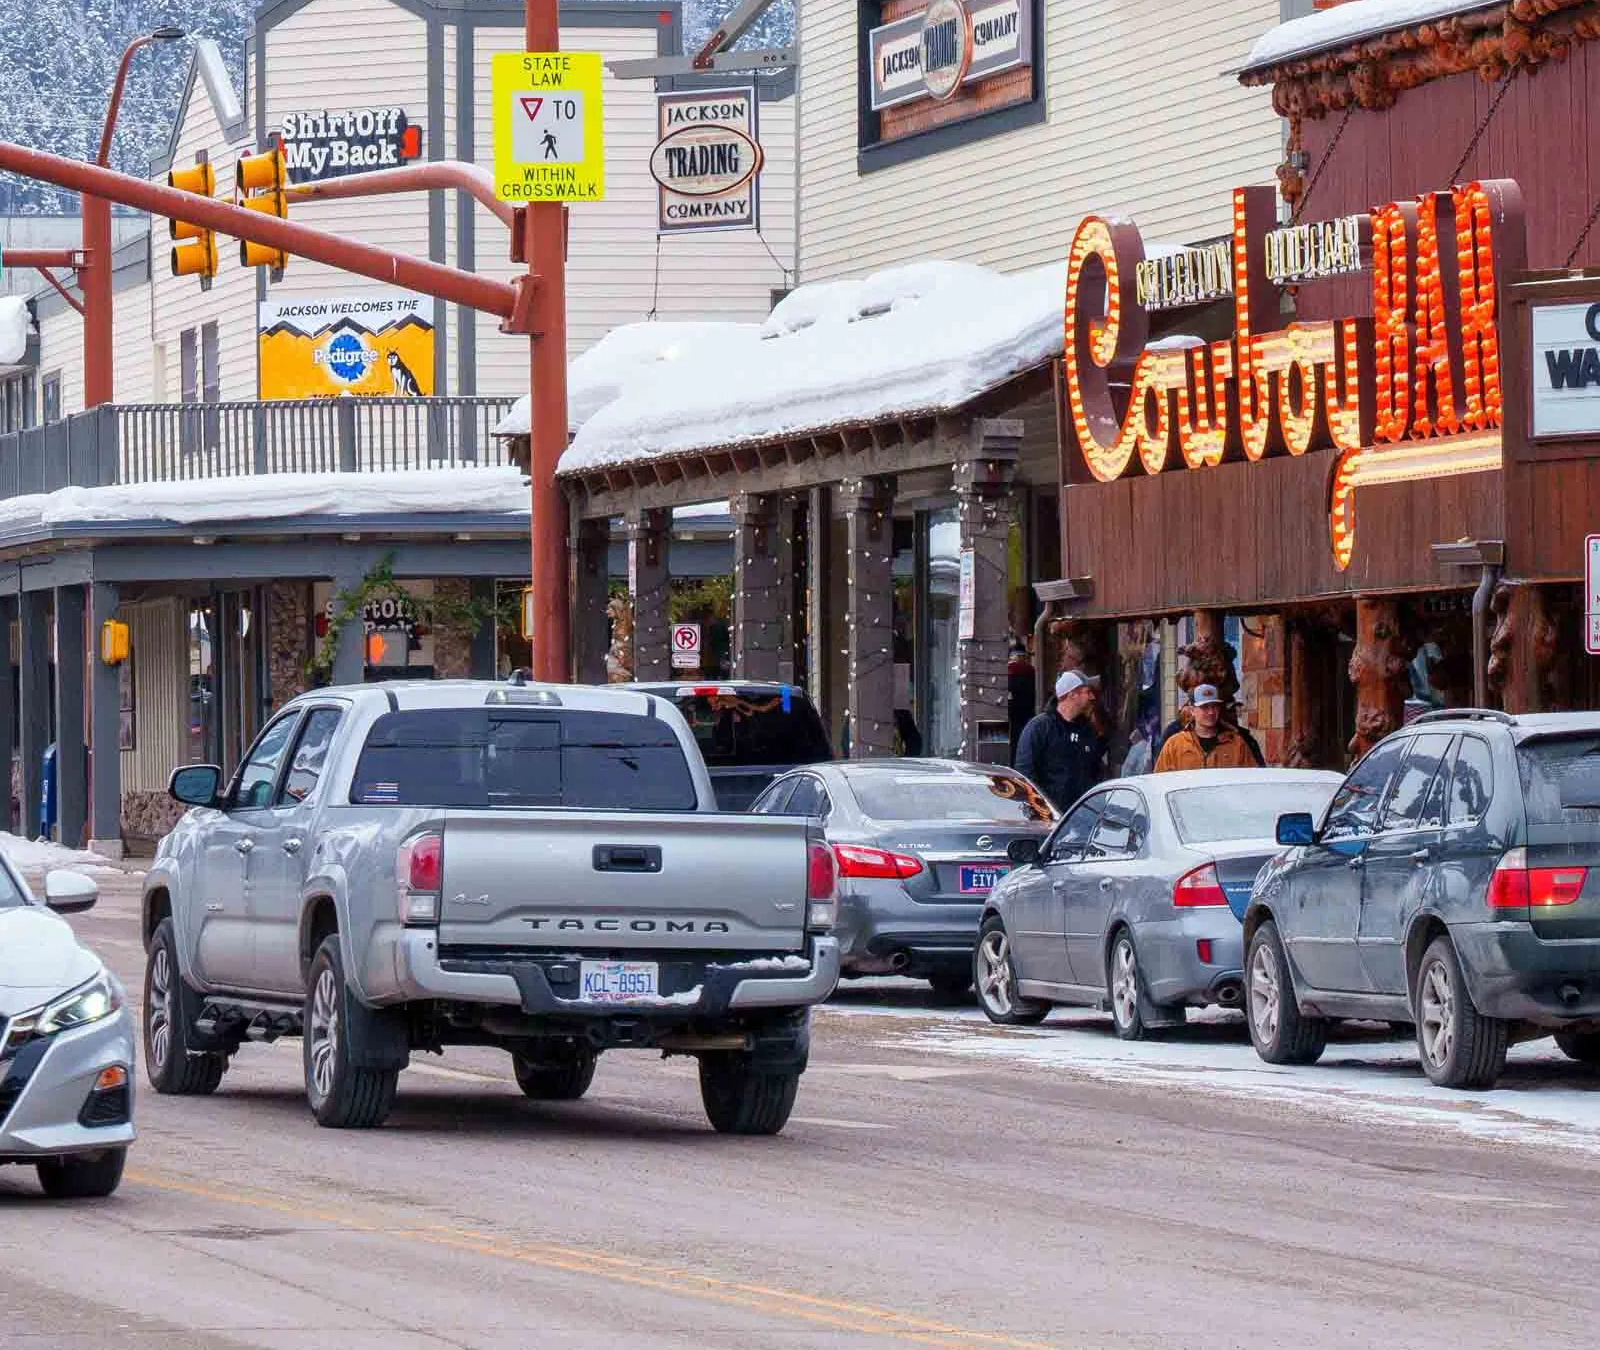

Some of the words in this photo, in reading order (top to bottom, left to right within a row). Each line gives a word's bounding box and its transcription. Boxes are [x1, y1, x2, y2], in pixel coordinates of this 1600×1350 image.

[882, 44, 920, 83] JACKSON
[974, 11, 1018, 46] COMPANY
[523, 57, 570, 70] STATE
[531, 73, 562, 86] LAW
[552, 99, 576, 120] TO
[667, 103, 745, 127] JACKSON
[665, 142, 740, 178] TRADING
[523, 168, 576, 182] WITHIN
[502, 183, 597, 197] CROSSWALK
[666, 199, 748, 219] COMPANY
[277, 304, 328, 317] JACKSON
[331, 300, 393, 314] WELCOMES
[398, 299, 419, 310] THE
[1369, 180, 1504, 444] BAR
[313, 347, 378, 366] Pedigree
[1592, 543, 1598, 551] 3
[520, 918, 730, 933] TACOMA
[584, 973, 655, 993] KCL-8951
